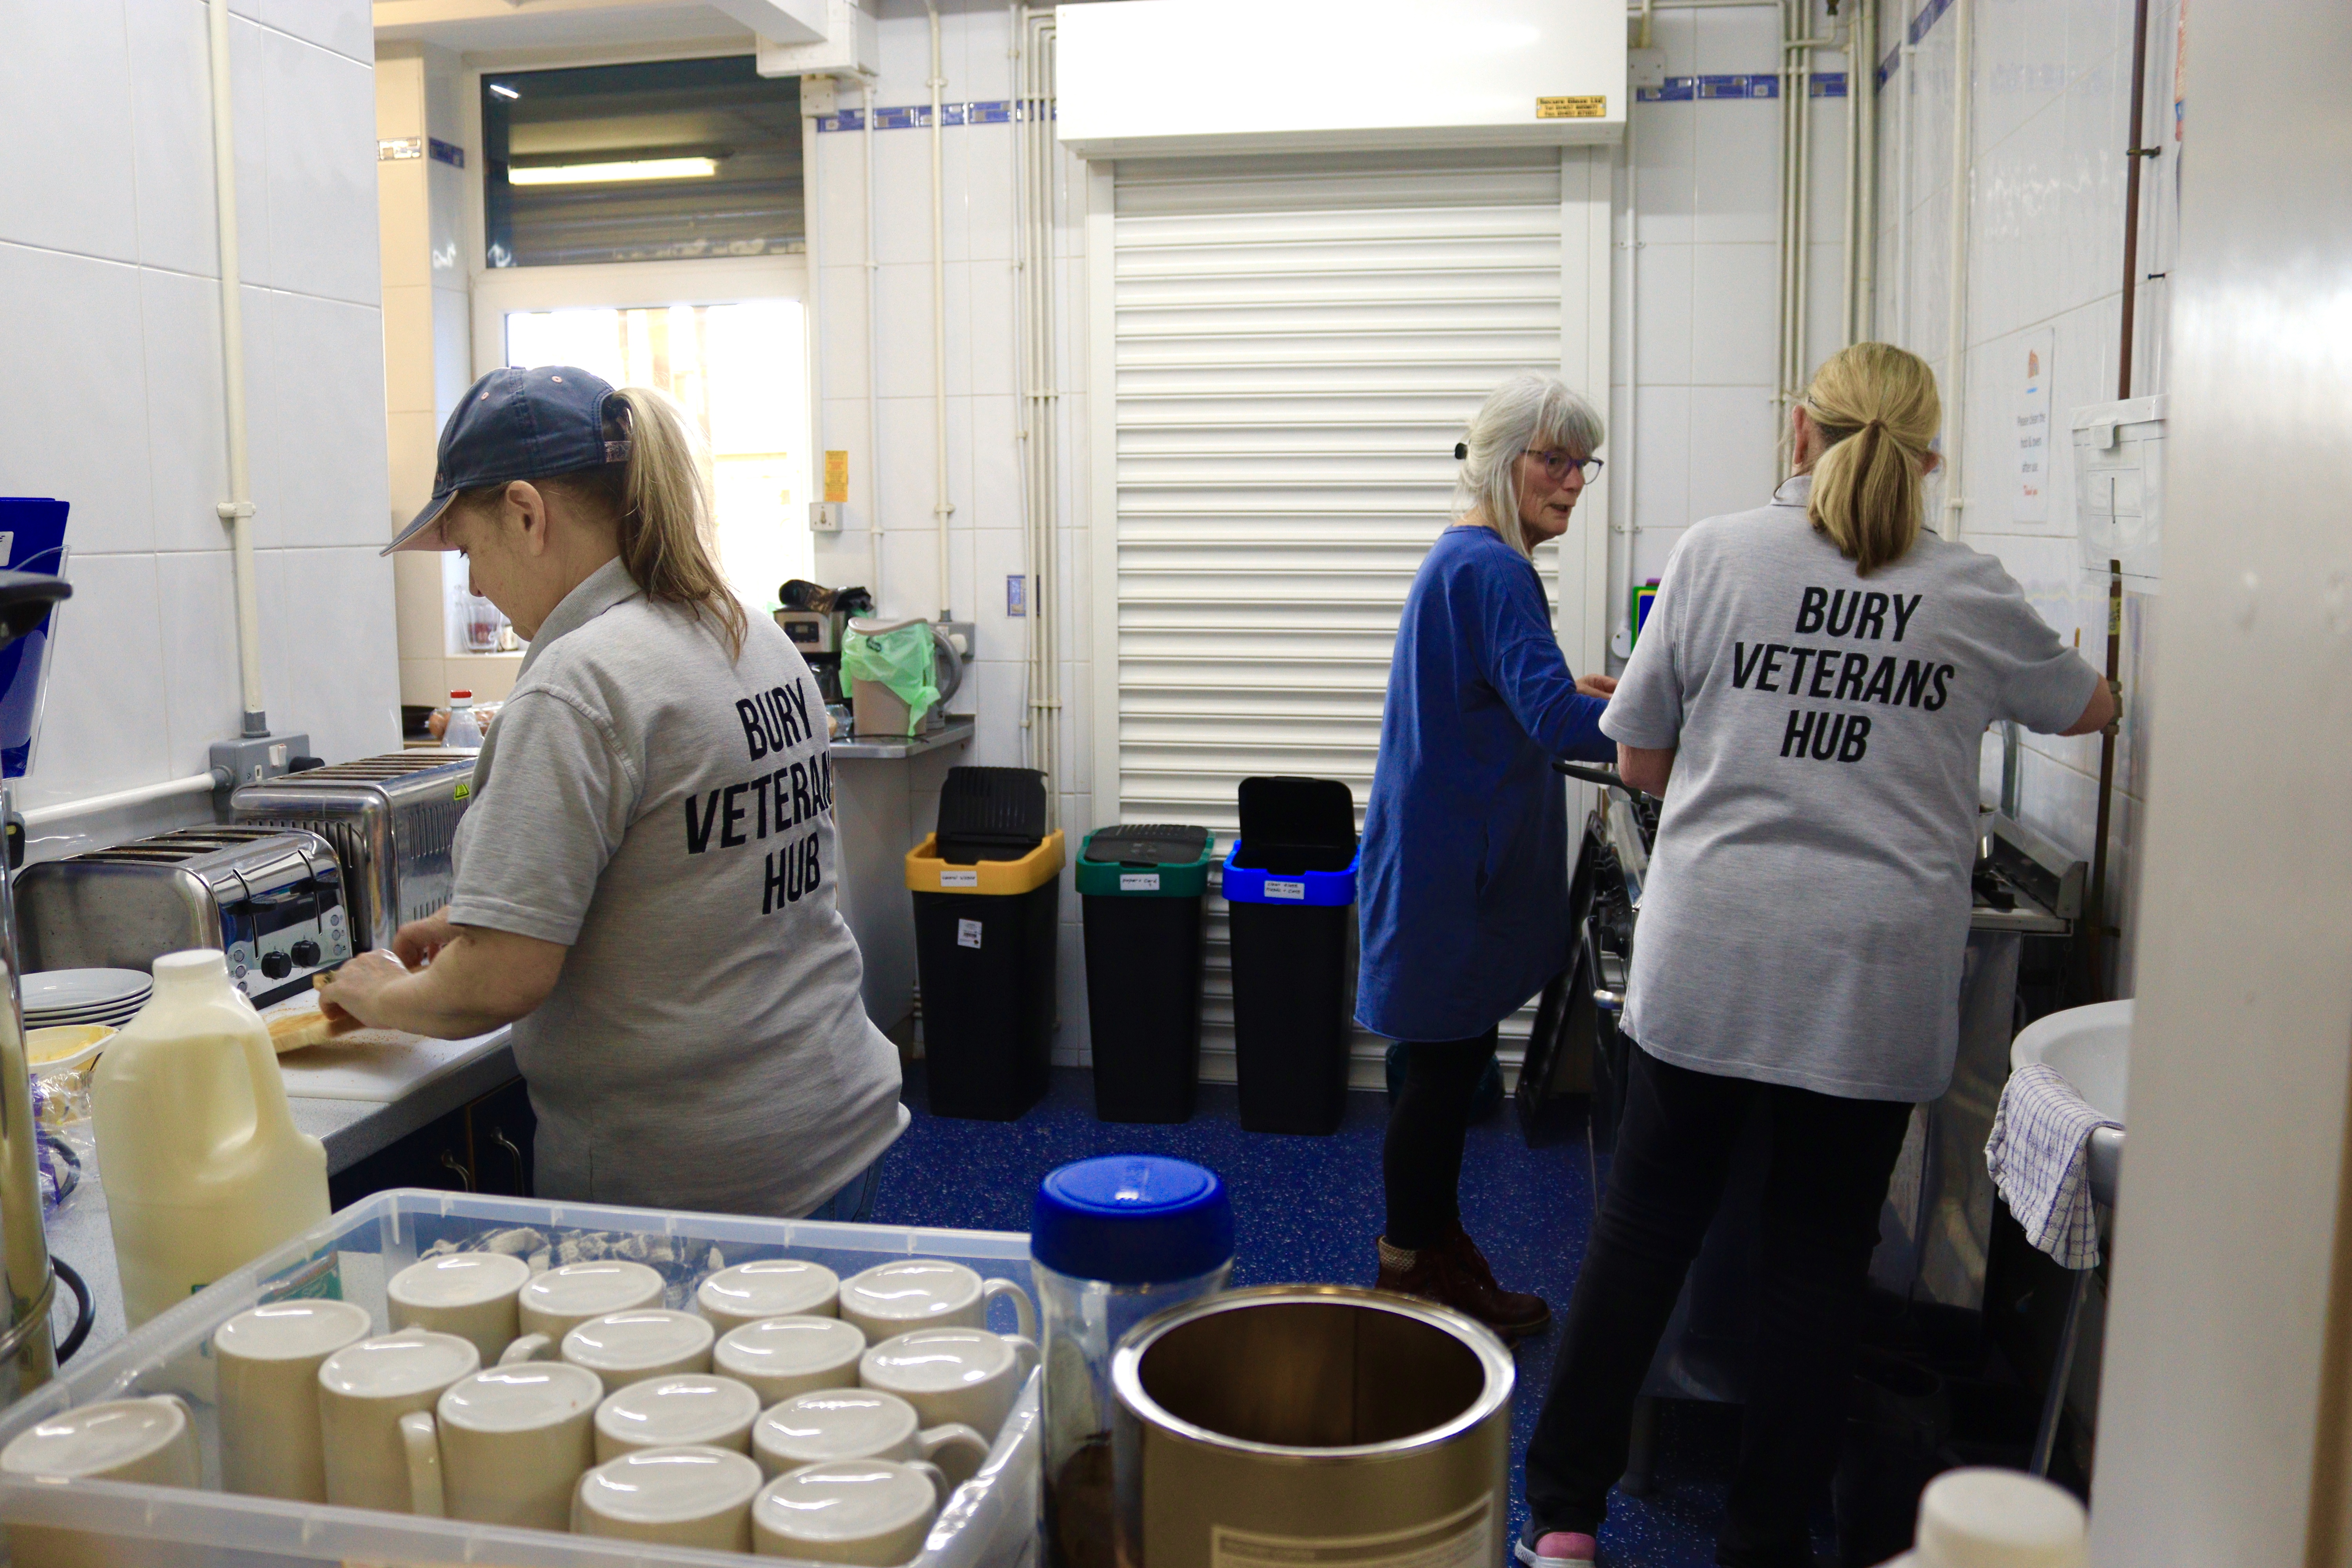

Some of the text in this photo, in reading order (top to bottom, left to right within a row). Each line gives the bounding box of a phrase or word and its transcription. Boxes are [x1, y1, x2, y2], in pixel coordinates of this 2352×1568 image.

[1795, 586, 1923, 642] BURY
[1733, 642, 1955, 711] VETERANS
[735, 677, 812, 761] BURY
[1780, 710, 1871, 763] HUB
[685, 750, 832, 855] VETERAN
[762, 832, 820, 915] HUB
